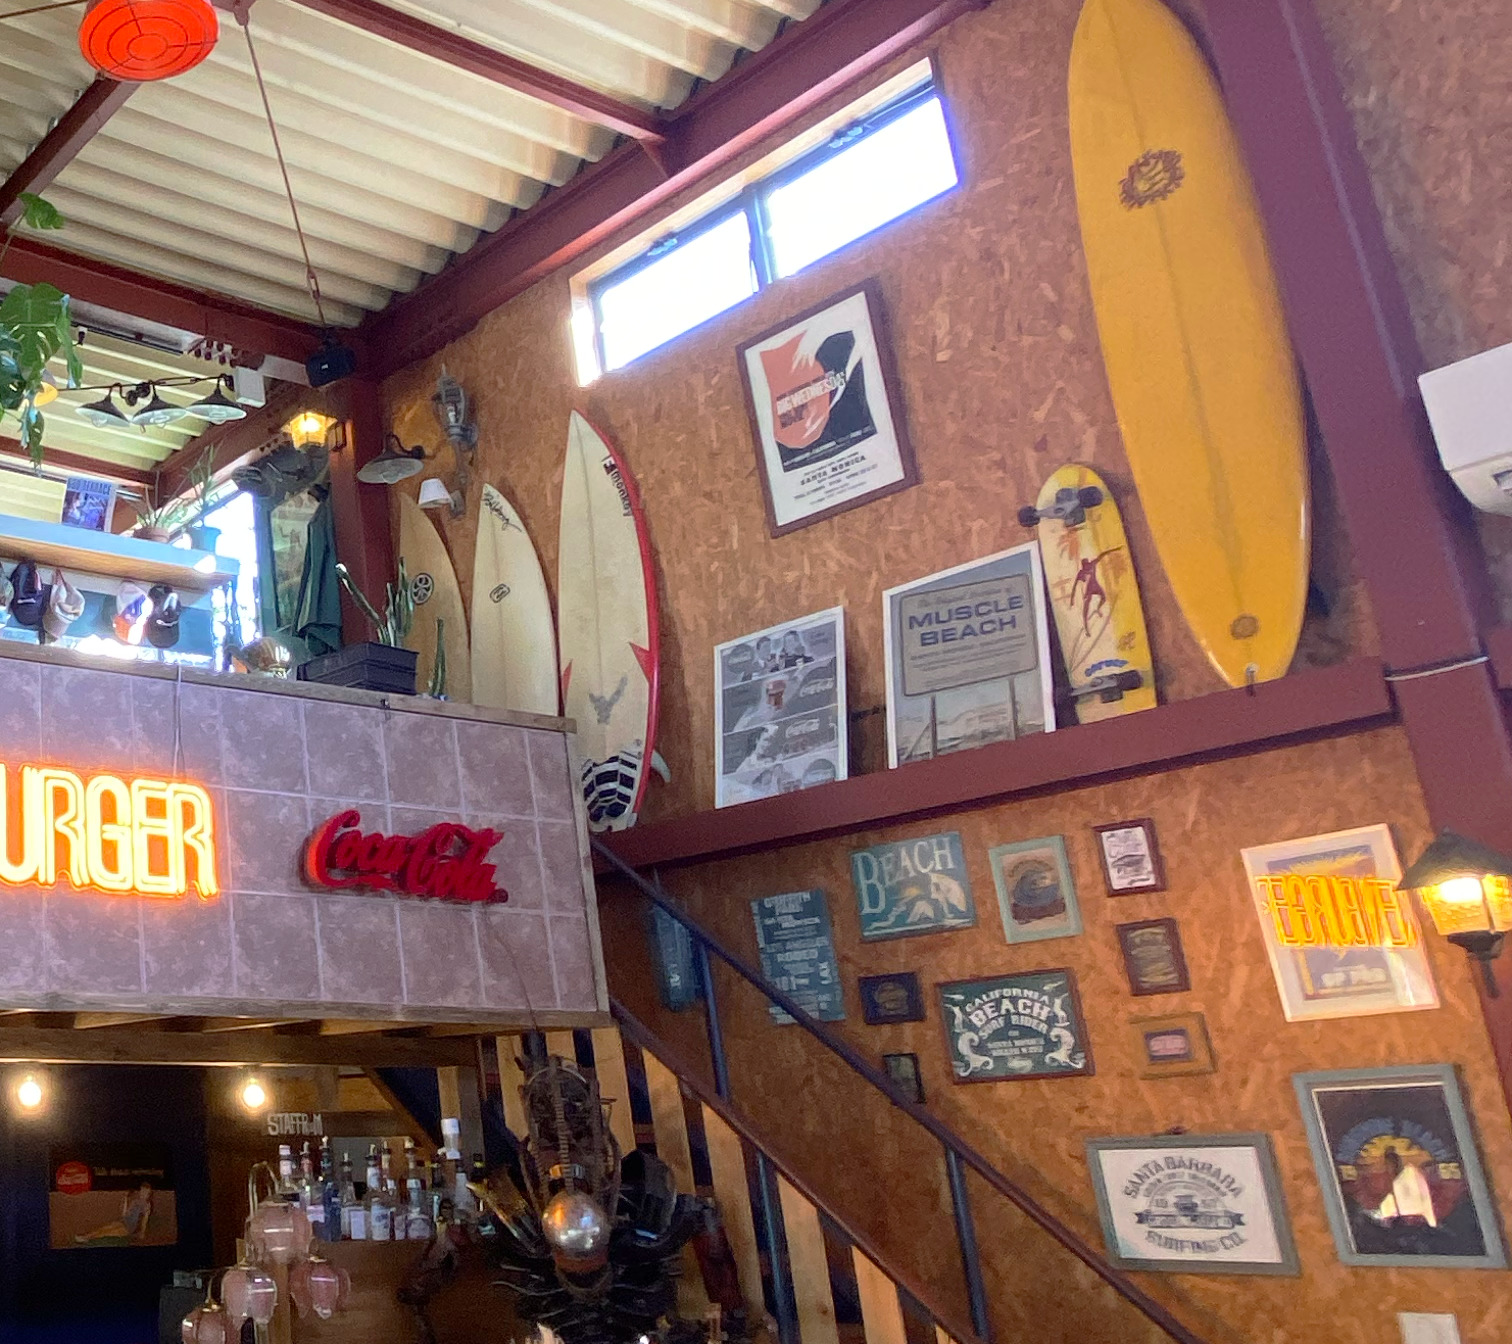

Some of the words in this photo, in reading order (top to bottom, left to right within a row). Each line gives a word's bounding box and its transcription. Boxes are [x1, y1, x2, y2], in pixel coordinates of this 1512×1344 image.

[907, 594, 1025, 631] MUSCLE
[919, 614, 1018, 648] BEACH
[852, 836, 956, 915] BEACH
[965, 987, 1050, 1013] CALIFORNIA
[968, 998, 1052, 1029] BEACH
[1122, 1158, 1165, 1200] SANTA
[1163, 1155, 1244, 1199] BARBARA
